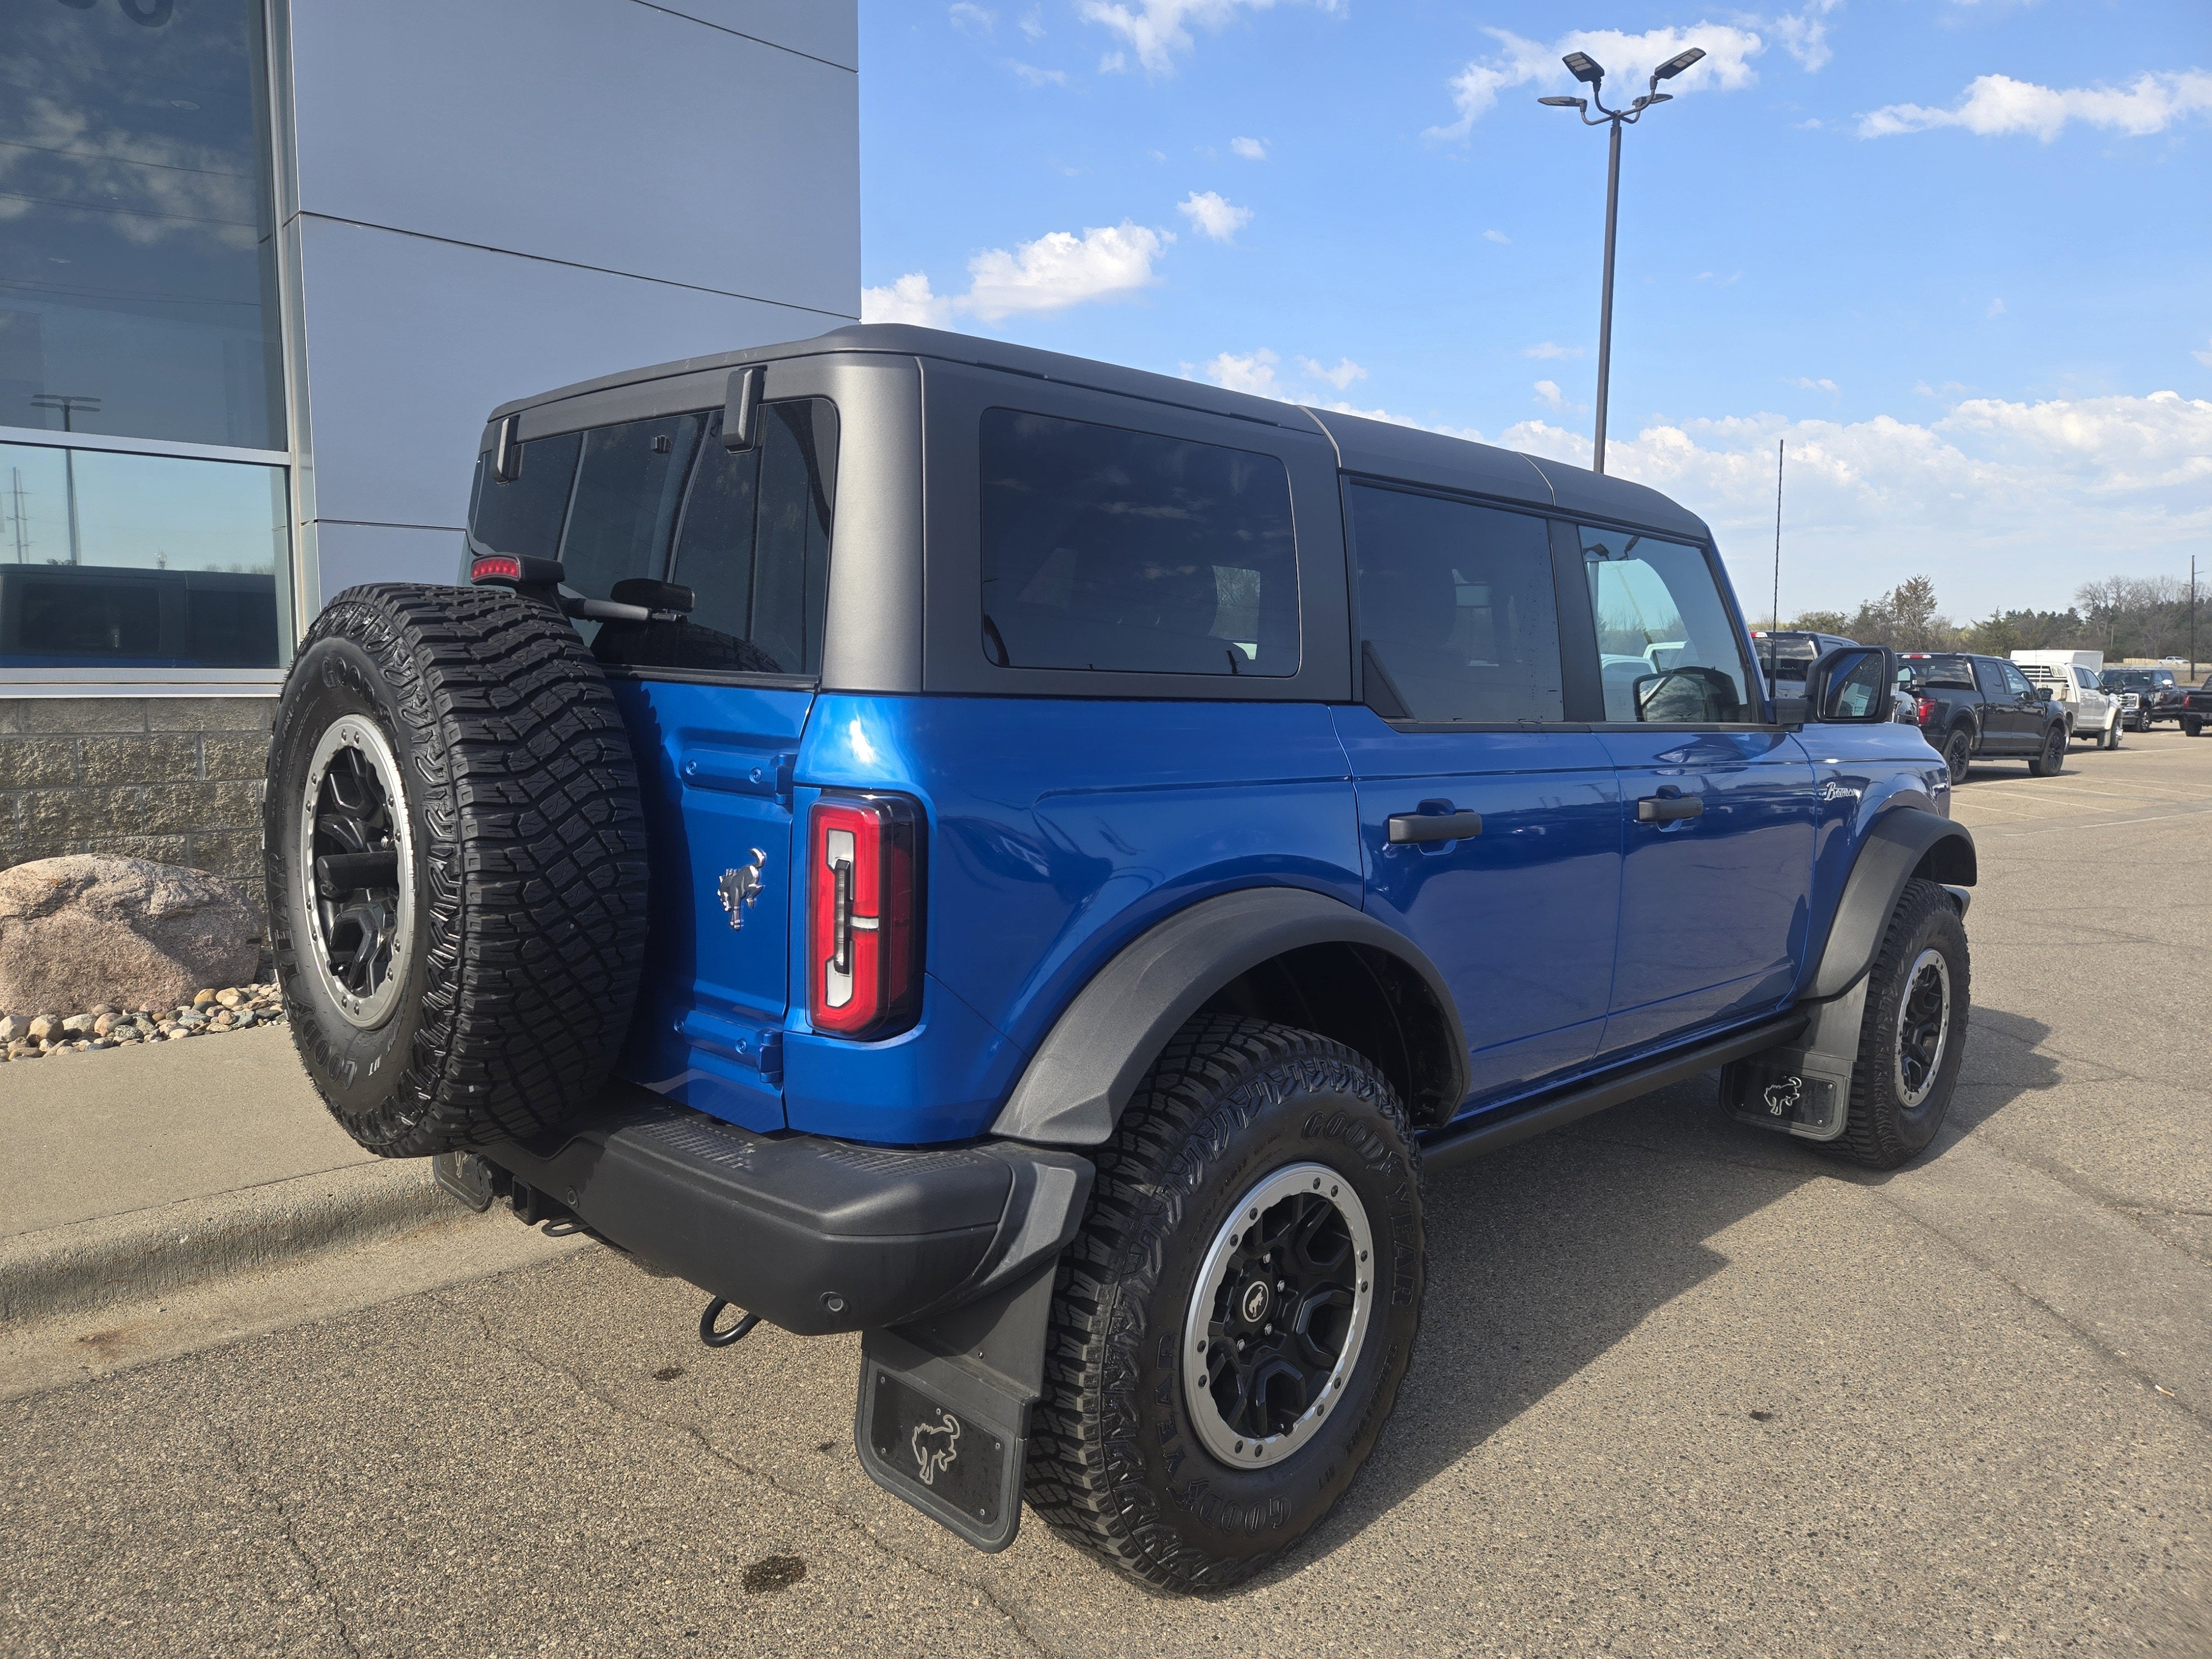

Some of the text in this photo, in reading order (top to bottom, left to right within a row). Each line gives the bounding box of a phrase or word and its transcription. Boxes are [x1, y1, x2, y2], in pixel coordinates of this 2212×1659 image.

[1823, 781, 1856, 801] Bronco
[268, 853, 357, 1091] GOODYEAR
[1301, 1109, 1417, 1306] GOODYEAR
[1156, 1332, 1291, 1536] GOODYEAR
[1344, 1344, 1399, 1460] TERRITORY
